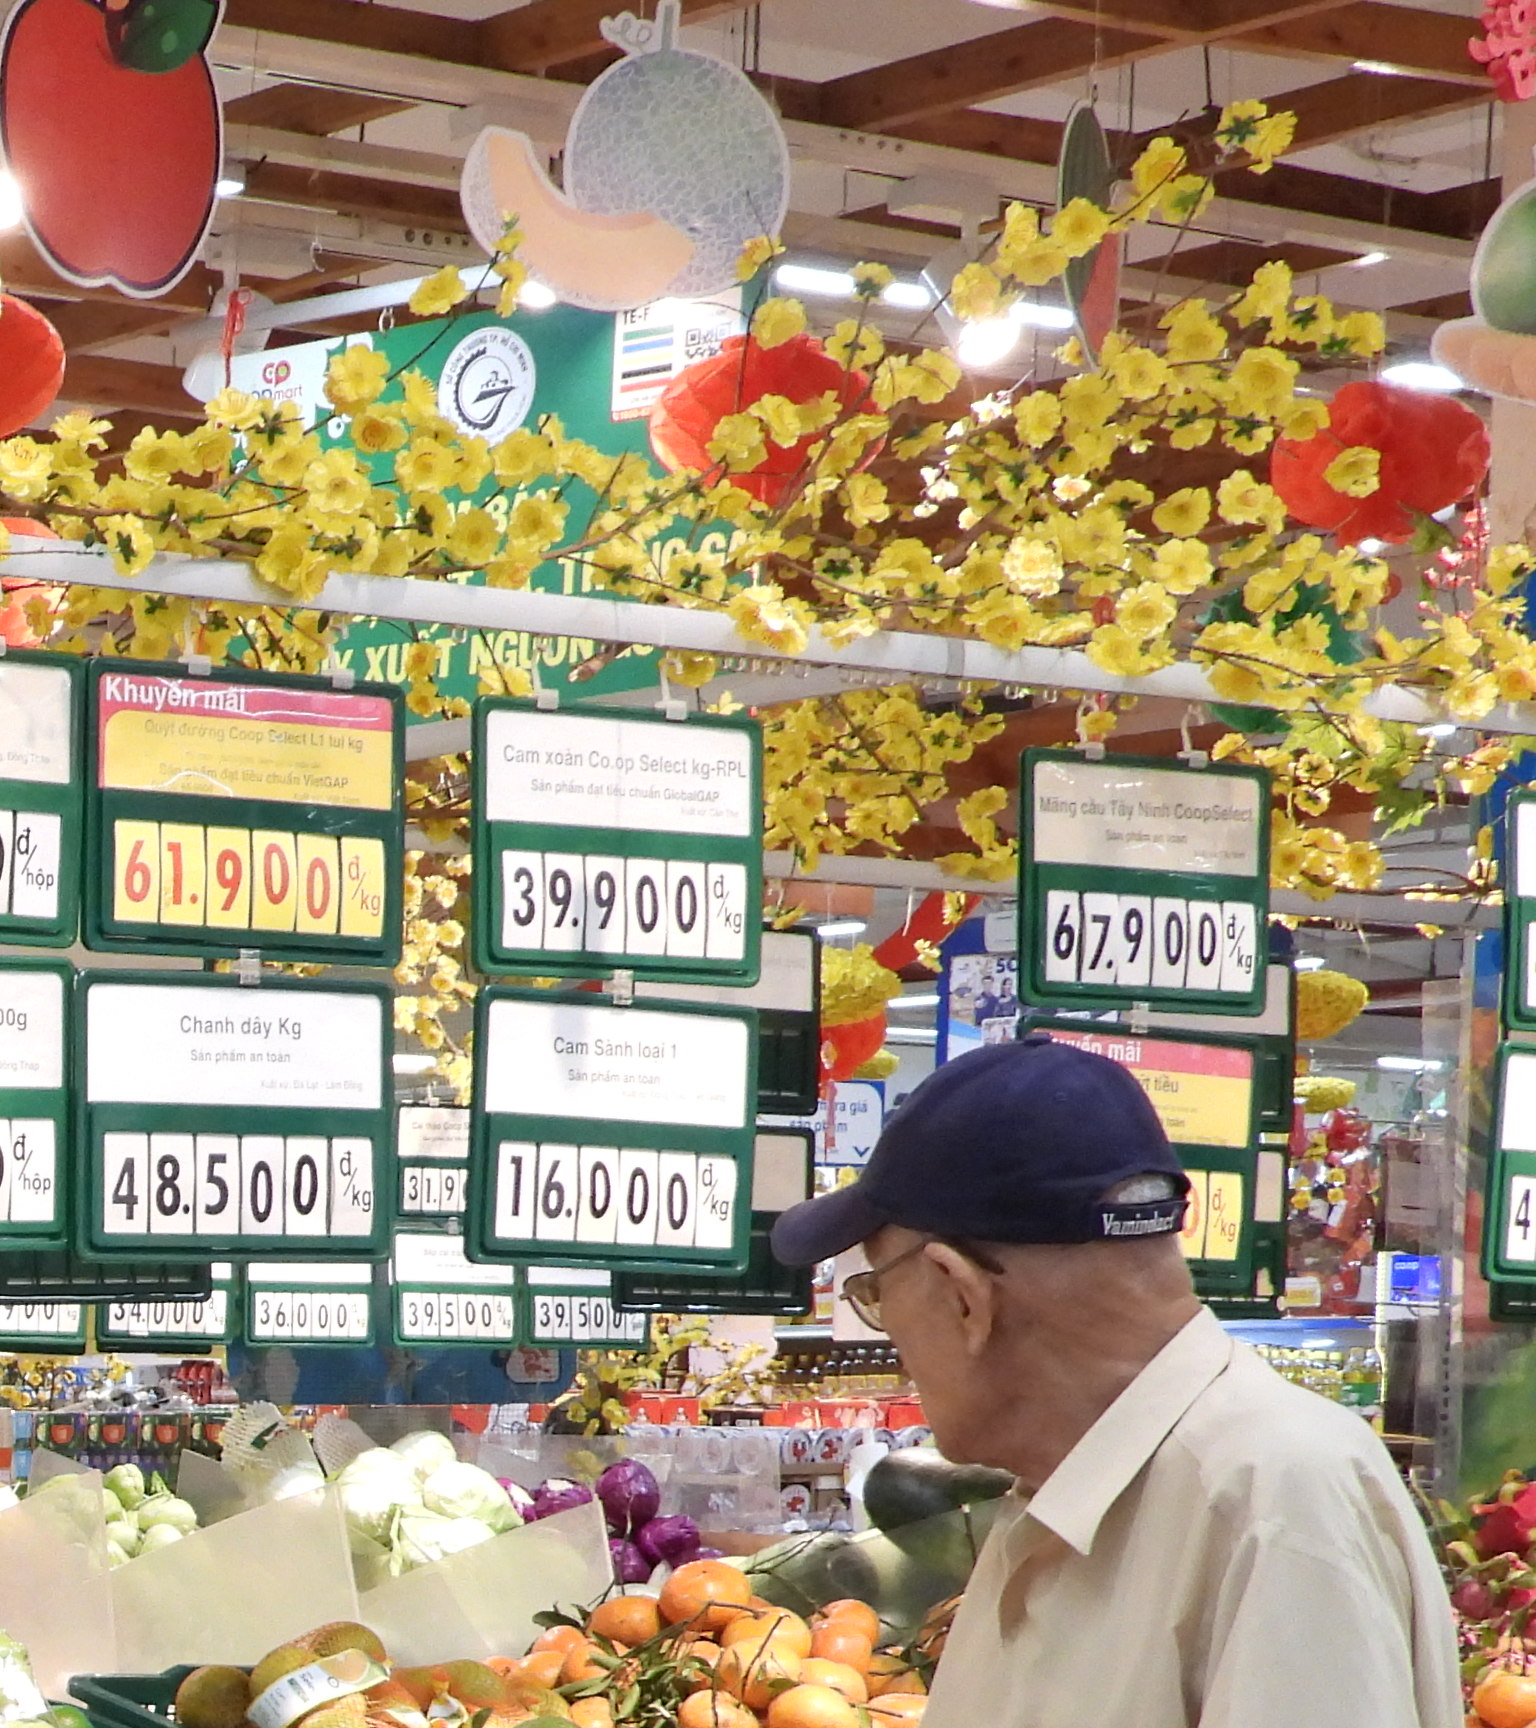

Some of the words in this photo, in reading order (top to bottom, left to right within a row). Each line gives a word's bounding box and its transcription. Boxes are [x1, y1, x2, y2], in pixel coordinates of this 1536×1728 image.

[348, 738, 363, 752] kg
[503, 744, 539, 764] Cam
[639, 755, 687, 775] Select
[124, 840, 330, 919] 61.900
[512, 868, 697, 933] 39.900
[1053, 905, 1216, 970] 67.900
[180, 1016, 234, 1035] Chanh
[241, 1016, 273, 1039] dây
[278, 1017, 301, 1039] Kg
[554, 1036, 589, 1055] Cam
[112, 1153, 318, 1223] 48.500
[510, 1156, 687, 1229] 16.000
[260, 1300, 348, 1328] 36.000
[408, 1300, 492, 1327] 39.500
